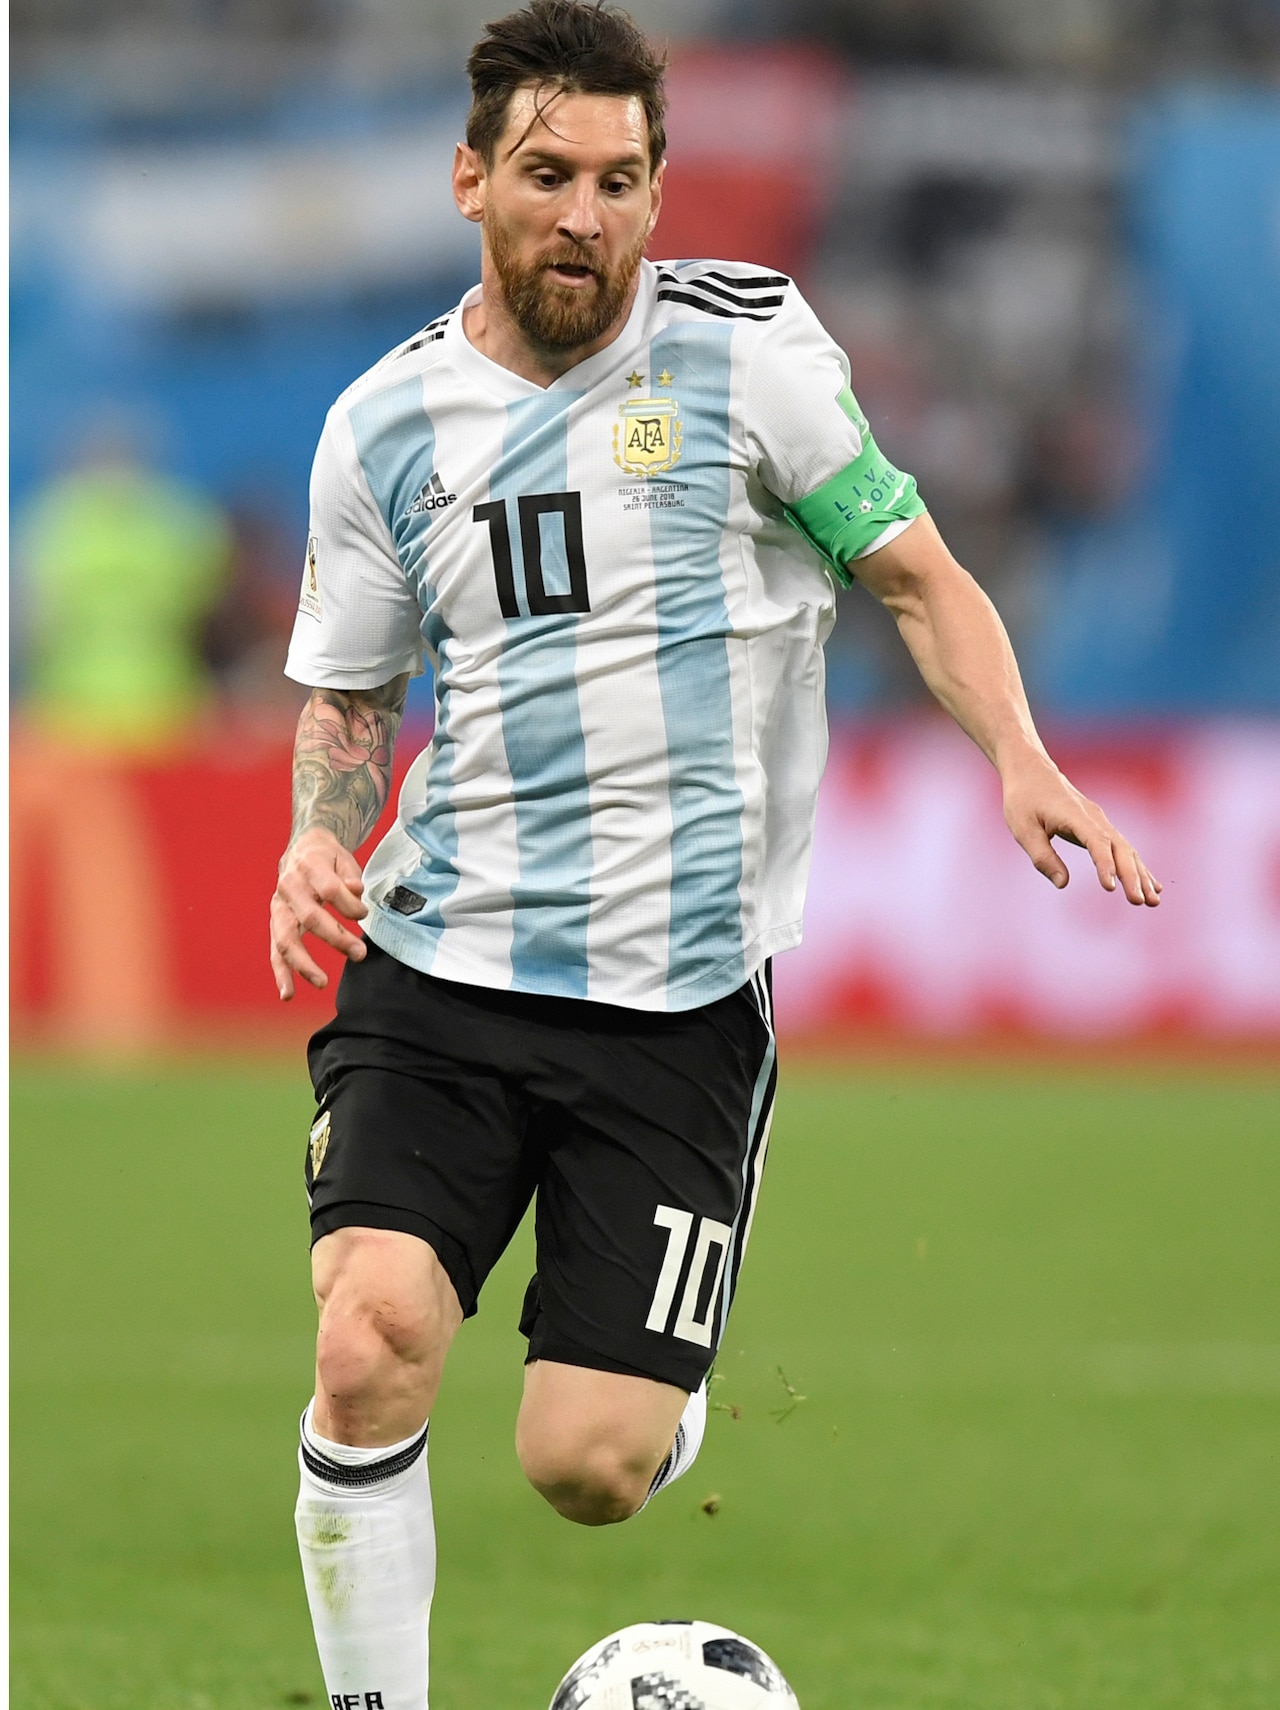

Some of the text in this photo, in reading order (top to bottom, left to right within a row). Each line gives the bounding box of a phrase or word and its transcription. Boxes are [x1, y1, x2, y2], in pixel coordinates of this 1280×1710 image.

[627, 418, 665, 454] AFA
[631, 493, 675, 503] 26 JUNE 2018
[651, 484, 689, 493] ARGENTINA
[404, 493, 458, 516] adidas
[623, 500, 685, 511] SAINT PETERSBURG
[472, 491, 591, 619] 10
[645, 1204, 732, 1349] 10
